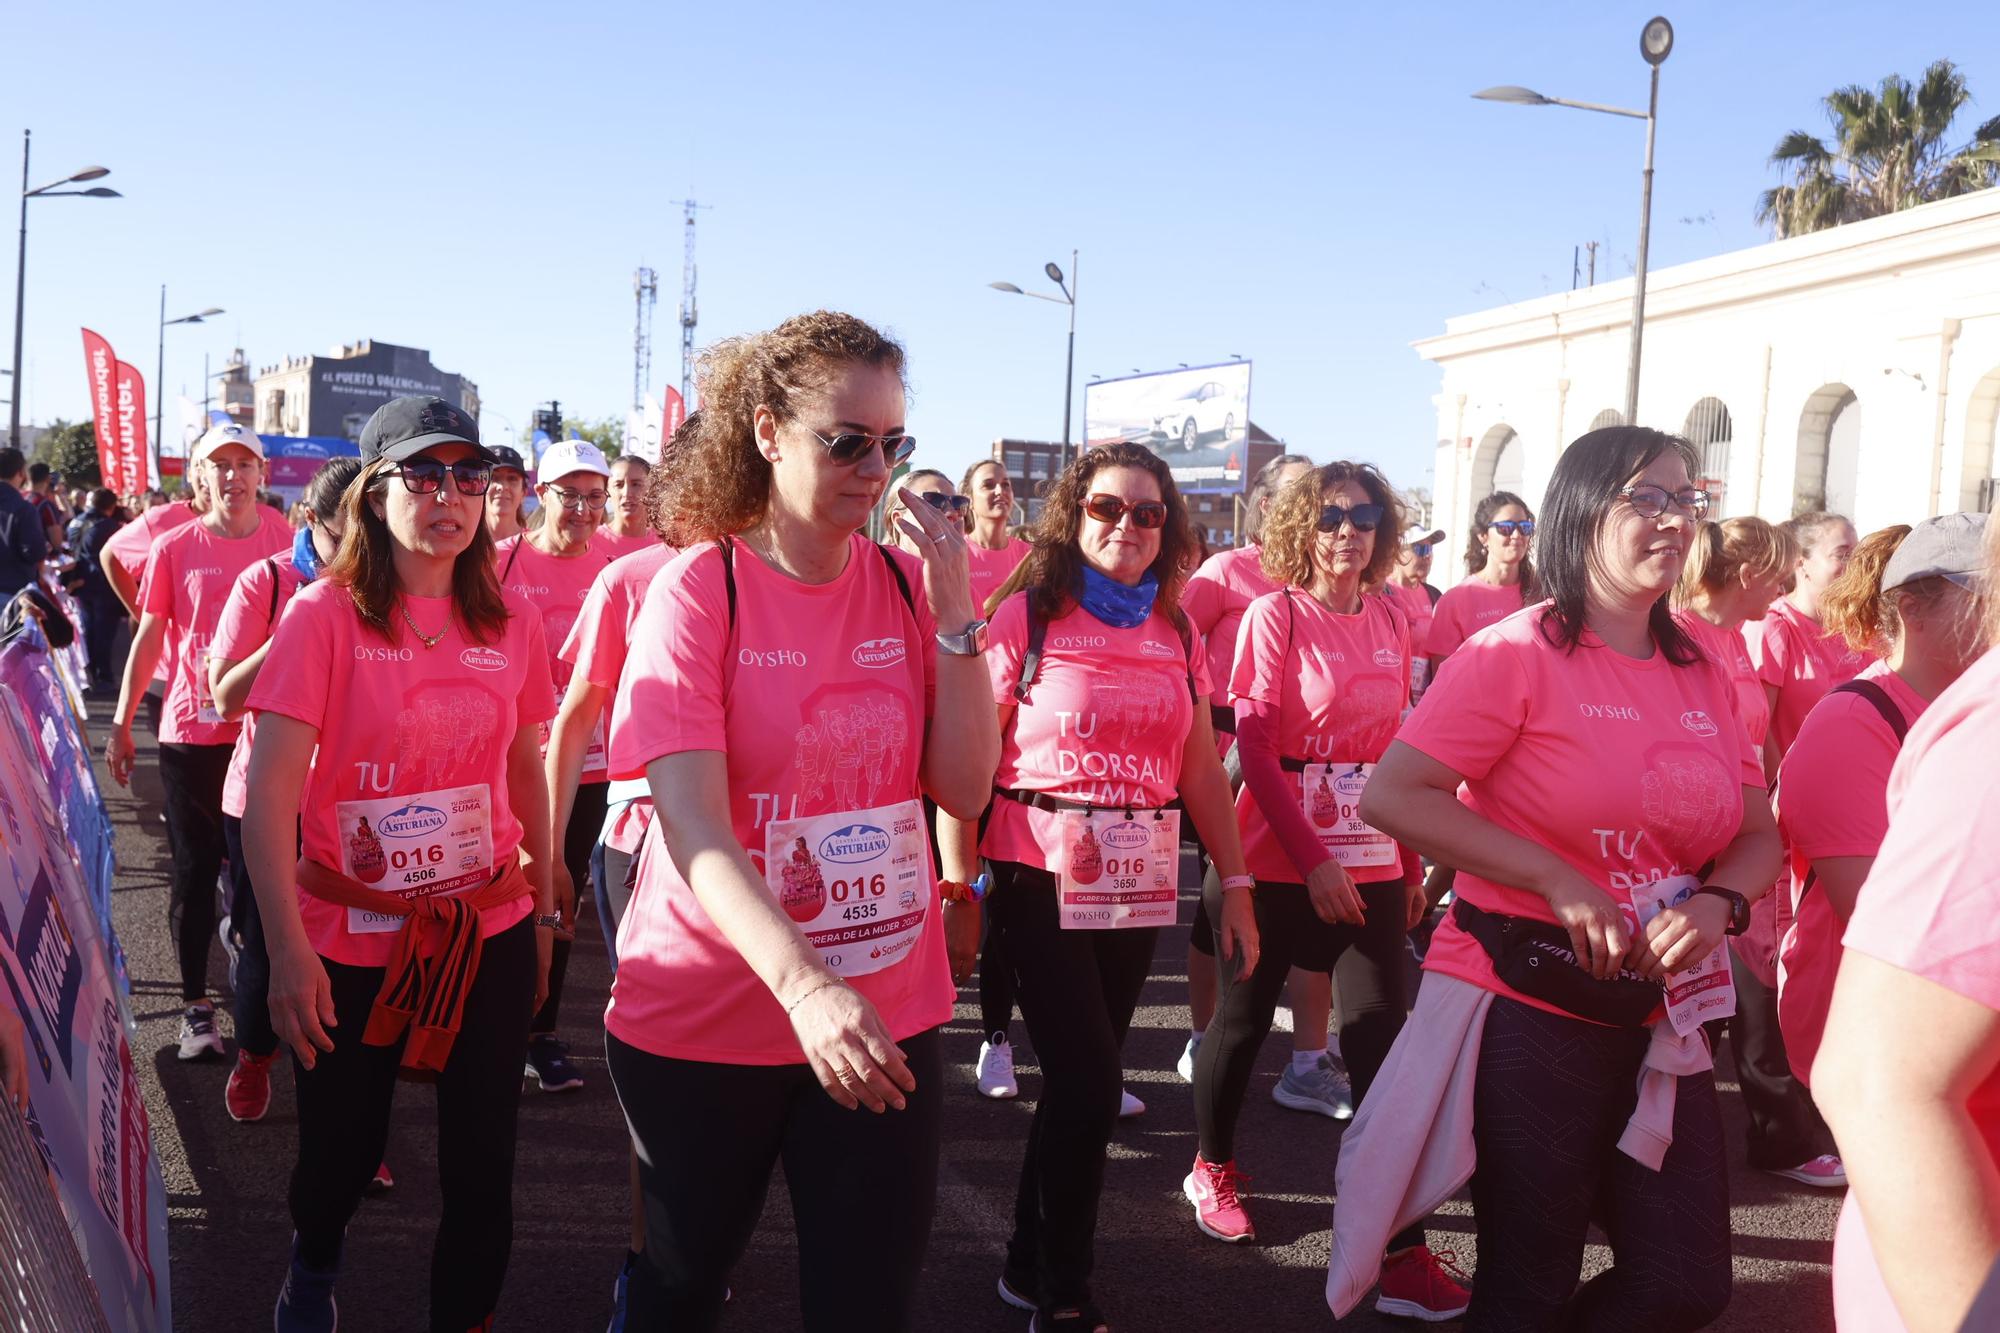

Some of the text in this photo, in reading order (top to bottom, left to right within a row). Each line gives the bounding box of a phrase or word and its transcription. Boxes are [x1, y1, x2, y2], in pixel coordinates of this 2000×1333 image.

[335, 372, 375, 387] PUERTO
[1054, 636, 1106, 648] OYSHO
[355, 645, 413, 661] OYSHO
[465, 655, 505, 666] ASTURIANA
[739, 648, 807, 667] OYSHO
[1579, 704, 1641, 721] OYSHO
[1055, 711, 1097, 738] TU
[1303, 734, 1334, 757] TU
[1058, 750, 1164, 784] DORSAL
[354, 761, 396, 792] TU
[452, 803, 480, 813] SUMA
[748, 793, 798, 828] TU
[1341, 804, 1360, 819] 01
[384, 817, 443, 833] ASTURIANA
[894, 823, 917, 835] SUMA
[1105, 831, 1147, 842] ASTURIANA
[1592, 829, 1645, 860] TU
[825, 839, 886, 857] ASTURIANA
[391, 845, 444, 868] 016
[1106, 859, 1144, 874] 016
[404, 868, 436, 883] 4506
[1113, 878, 1136, 889] 3650
[406, 890, 417, 899] DE
[420, 887, 430, 895] LA
[432, 880, 460, 892] MUJER
[831, 874, 885, 902] 016
[1131, 893, 1152, 901] MUJER
[843, 903, 877, 921] 4535
[1073, 911, 1110, 920] OYSHO
[1137, 909, 1169, 917] Santander
[843, 931, 856, 940] DE
[859, 928, 870, 937] LA
[872, 921, 899, 935] MUJER
